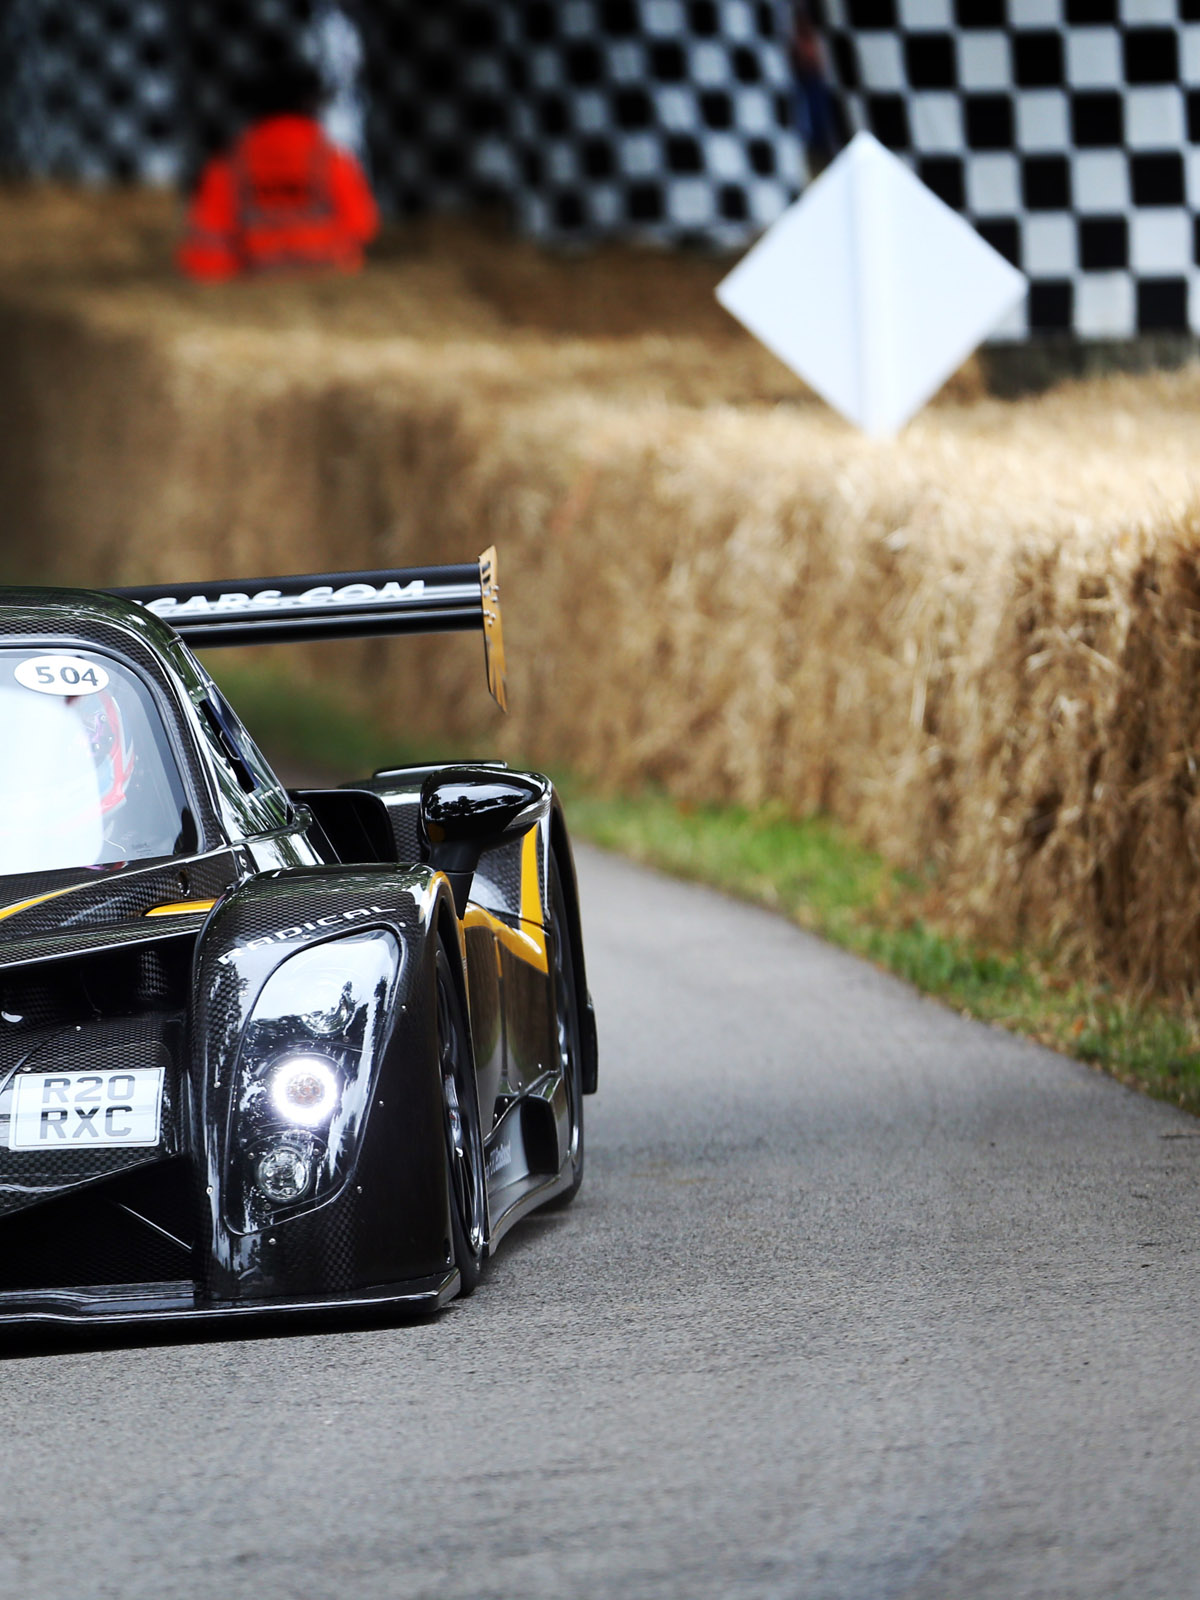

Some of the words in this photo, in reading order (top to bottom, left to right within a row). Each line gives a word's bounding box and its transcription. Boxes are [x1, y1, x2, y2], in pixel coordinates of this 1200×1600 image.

[131, 579, 425, 614] CARS.COM
[35, 666, 99, 687] 504
[216, 906, 397, 965] RADICAL
[42, 1075, 136, 1103] R20
[39, 1105, 133, 1139] RXC
